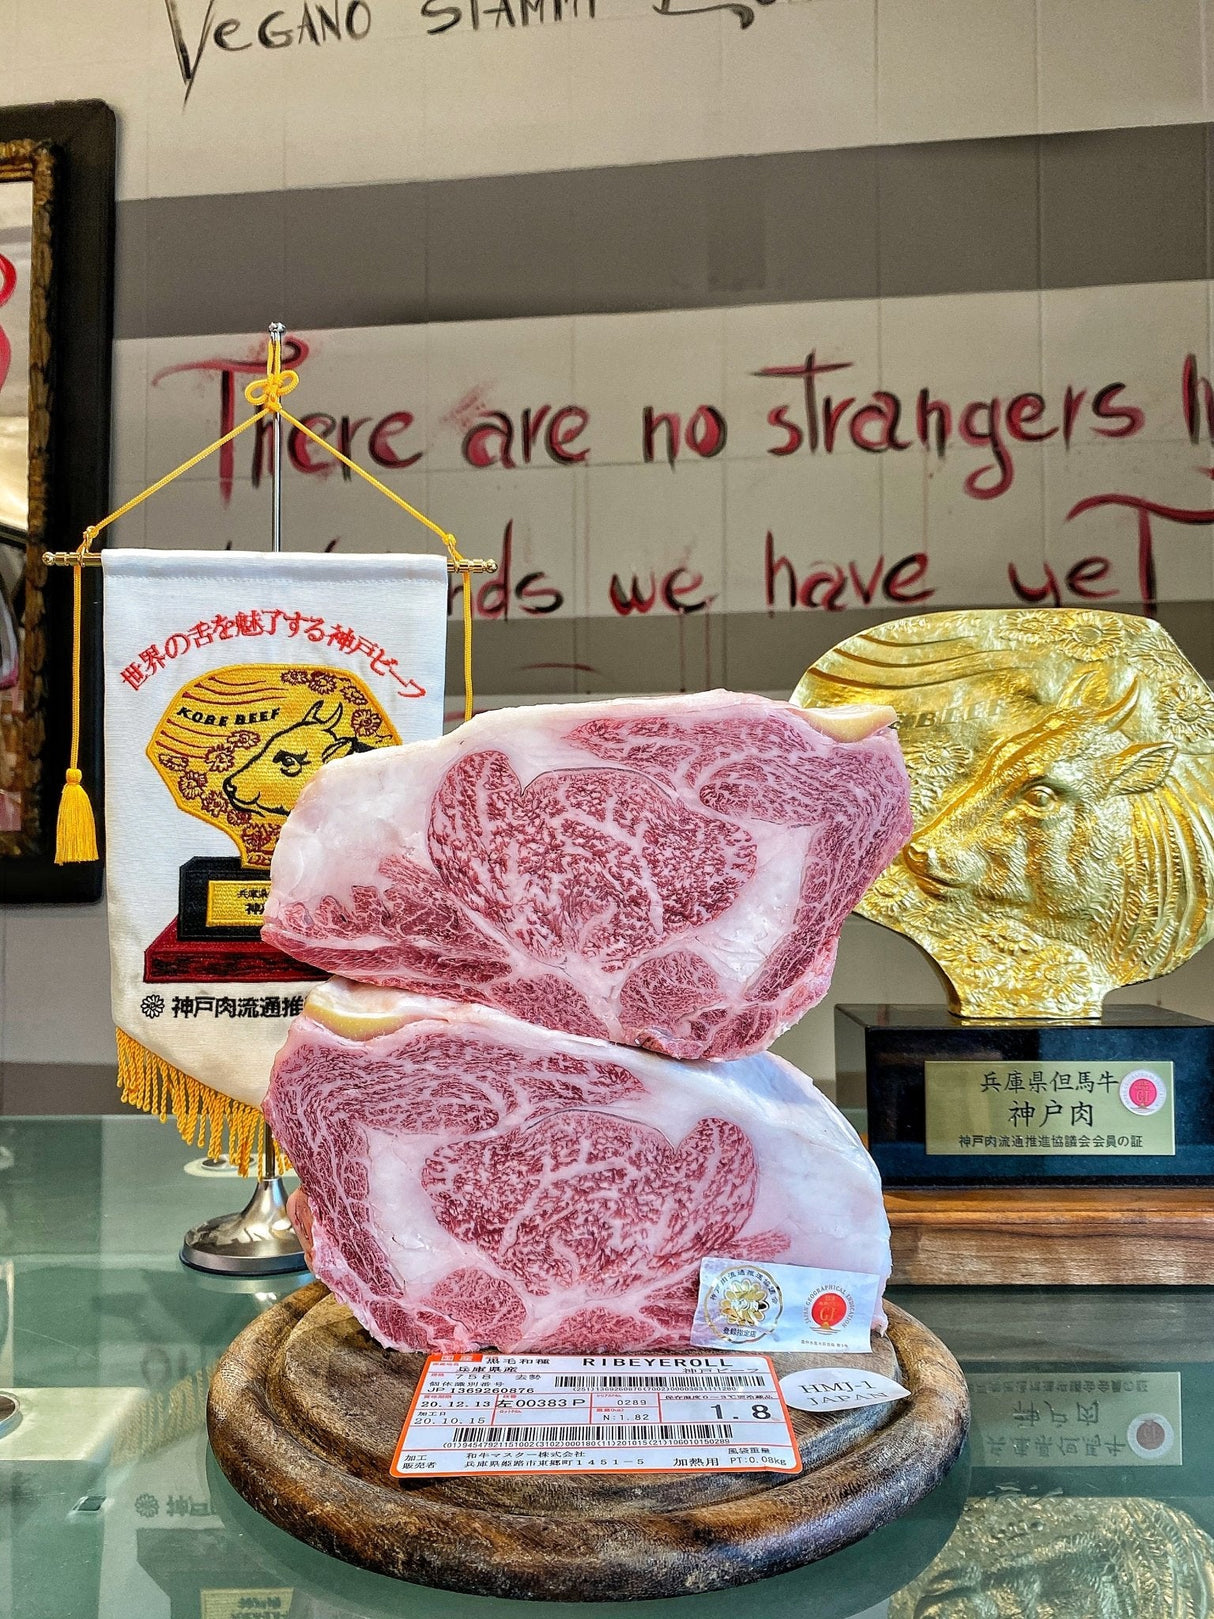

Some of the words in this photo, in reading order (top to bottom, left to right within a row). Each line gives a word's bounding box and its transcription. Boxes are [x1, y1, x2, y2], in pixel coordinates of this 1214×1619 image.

[460, 403, 592, 470] are
[642, 403, 728, 472] no
[608, 564, 718, 616] we
[765, 530, 937, 618] have
[119, 608, 427, 698] 世界の舌を魅了する神戸ビーフ
[176, 706, 228, 727] KOBE
[235, 706, 281, 726] BEEF
[980, 1070, 1120, 1094] 兵庫県但馬牛
[1007, 1100, 1094, 1128] 神戸肉
[958, 1134, 1143, 1149] 神戸肉流通推進協議会会員の証
[798, 1380, 877, 1394] HMJ-1
